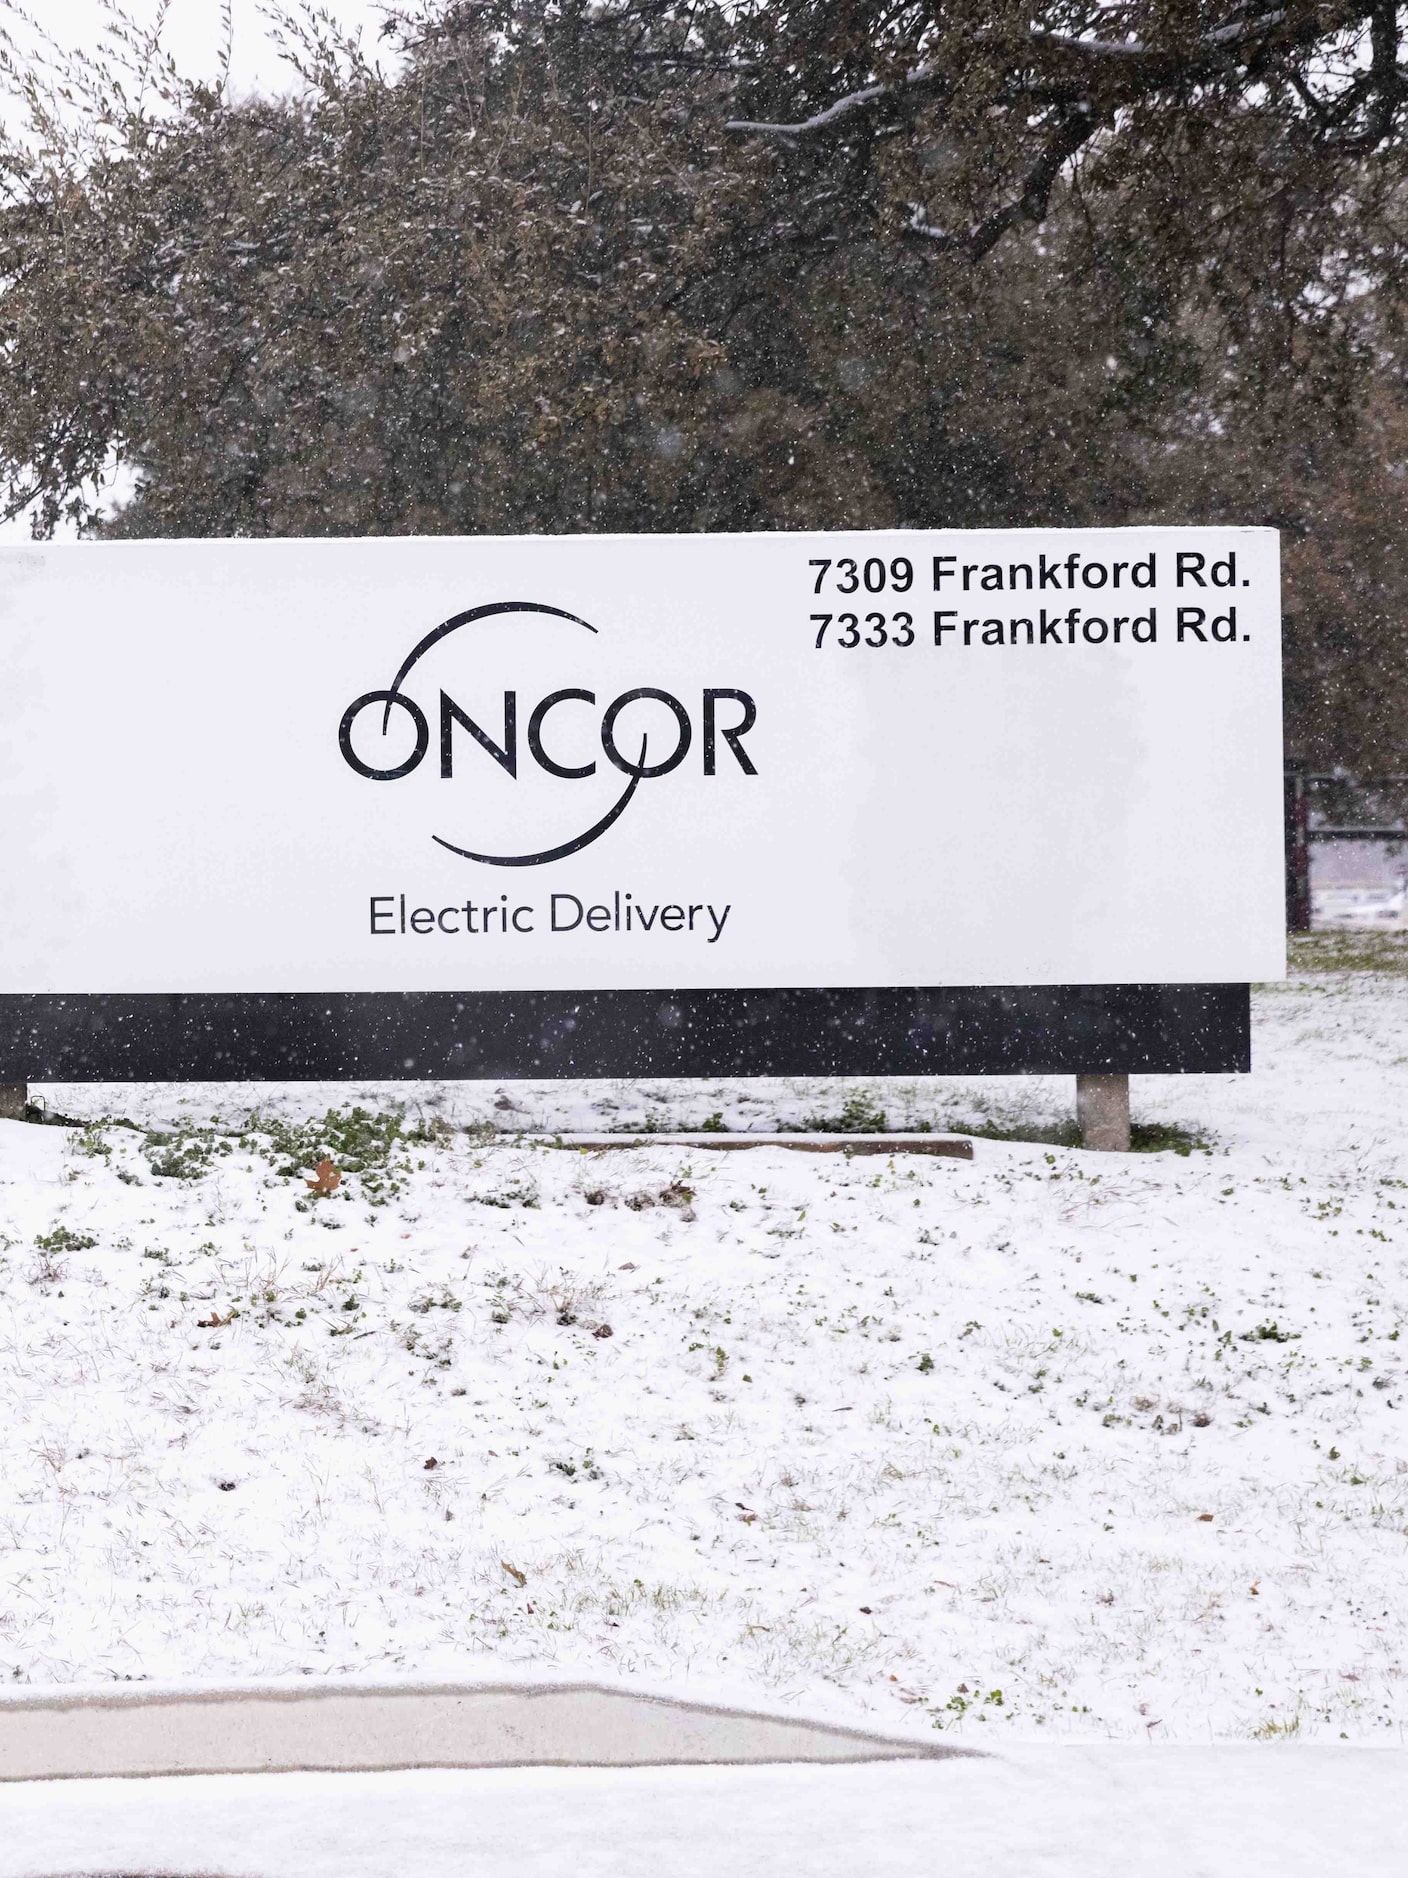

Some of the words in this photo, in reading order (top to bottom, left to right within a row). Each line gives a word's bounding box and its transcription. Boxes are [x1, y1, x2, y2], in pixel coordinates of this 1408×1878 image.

[808, 557, 914, 594] 7309
[932, 552, 1156, 592] Frankford
[1176, 551, 1250, 588] Rd.
[809, 611, 915, 649] 7333
[933, 607, 1157, 646] Frankford
[1176, 606, 1250, 643] Rd.
[338, 687, 759, 781] ONCOR
[370, 893, 534, 935] Electric
[550, 890, 731, 943] Delivery
